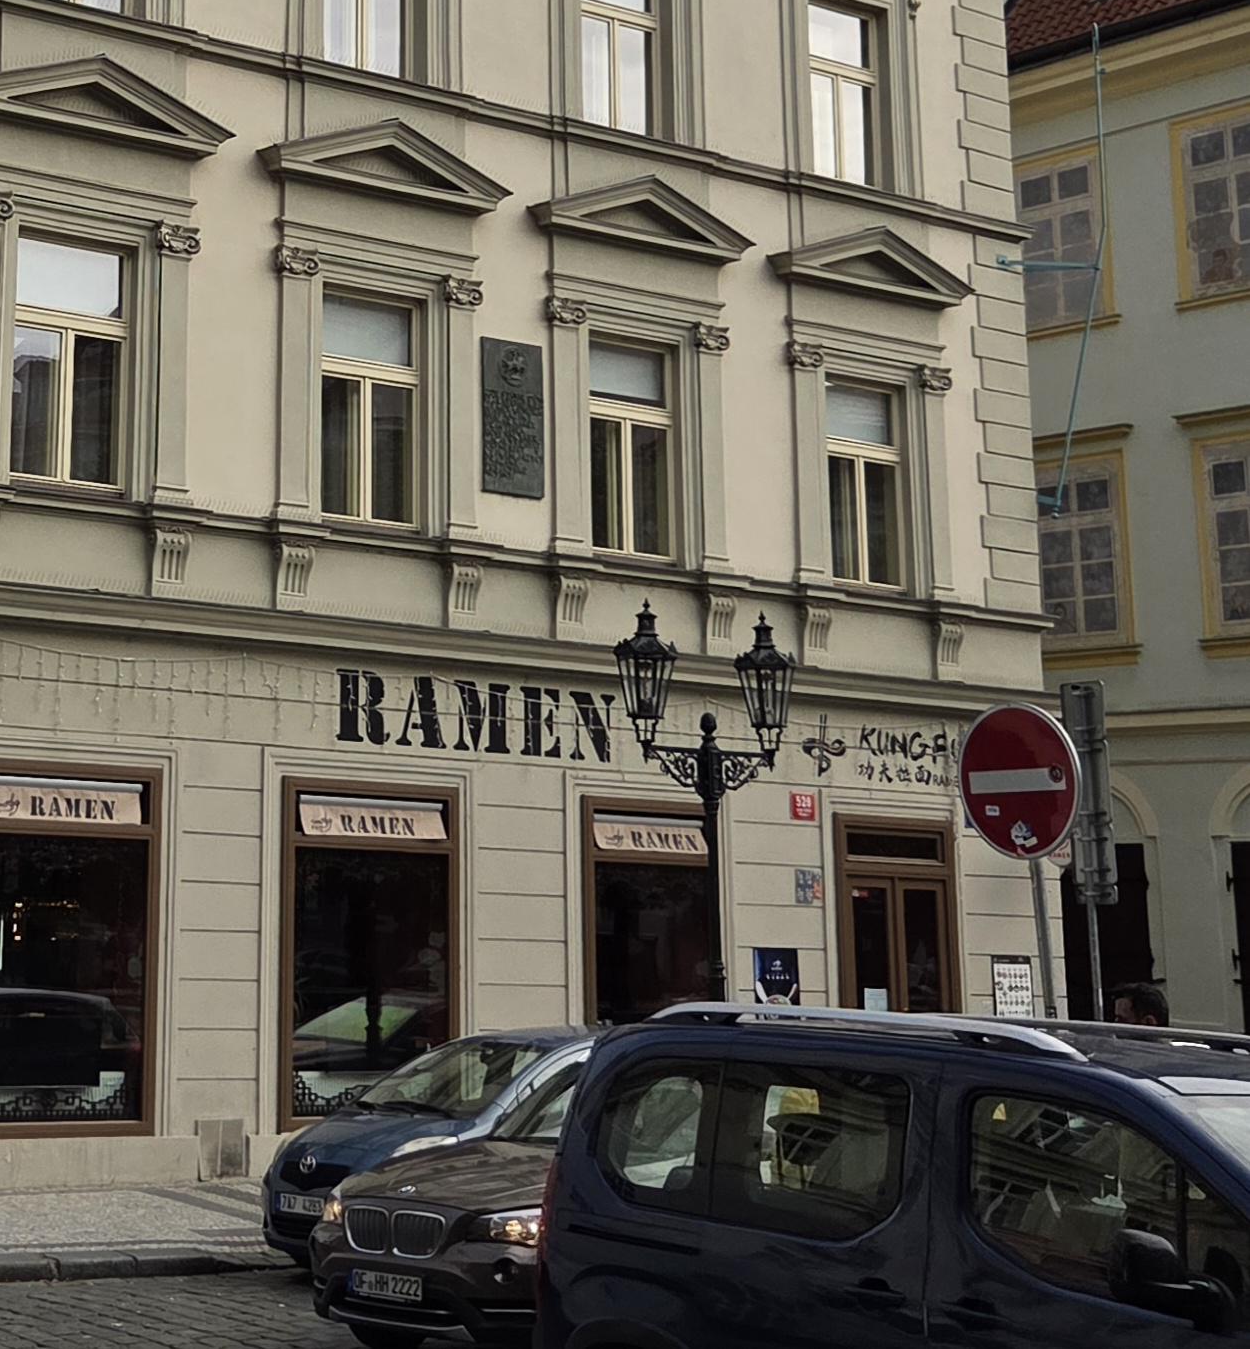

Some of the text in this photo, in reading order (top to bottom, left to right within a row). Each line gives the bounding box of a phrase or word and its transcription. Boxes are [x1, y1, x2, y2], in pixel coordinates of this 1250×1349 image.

[335, 668, 616, 763] RAMEN
[30, 795, 116, 820] RAMEN
[340, 814, 416, 836] RAMEN
[630, 830, 699, 852] RAMEN
[391, 1277, 420, 1298] 2222
